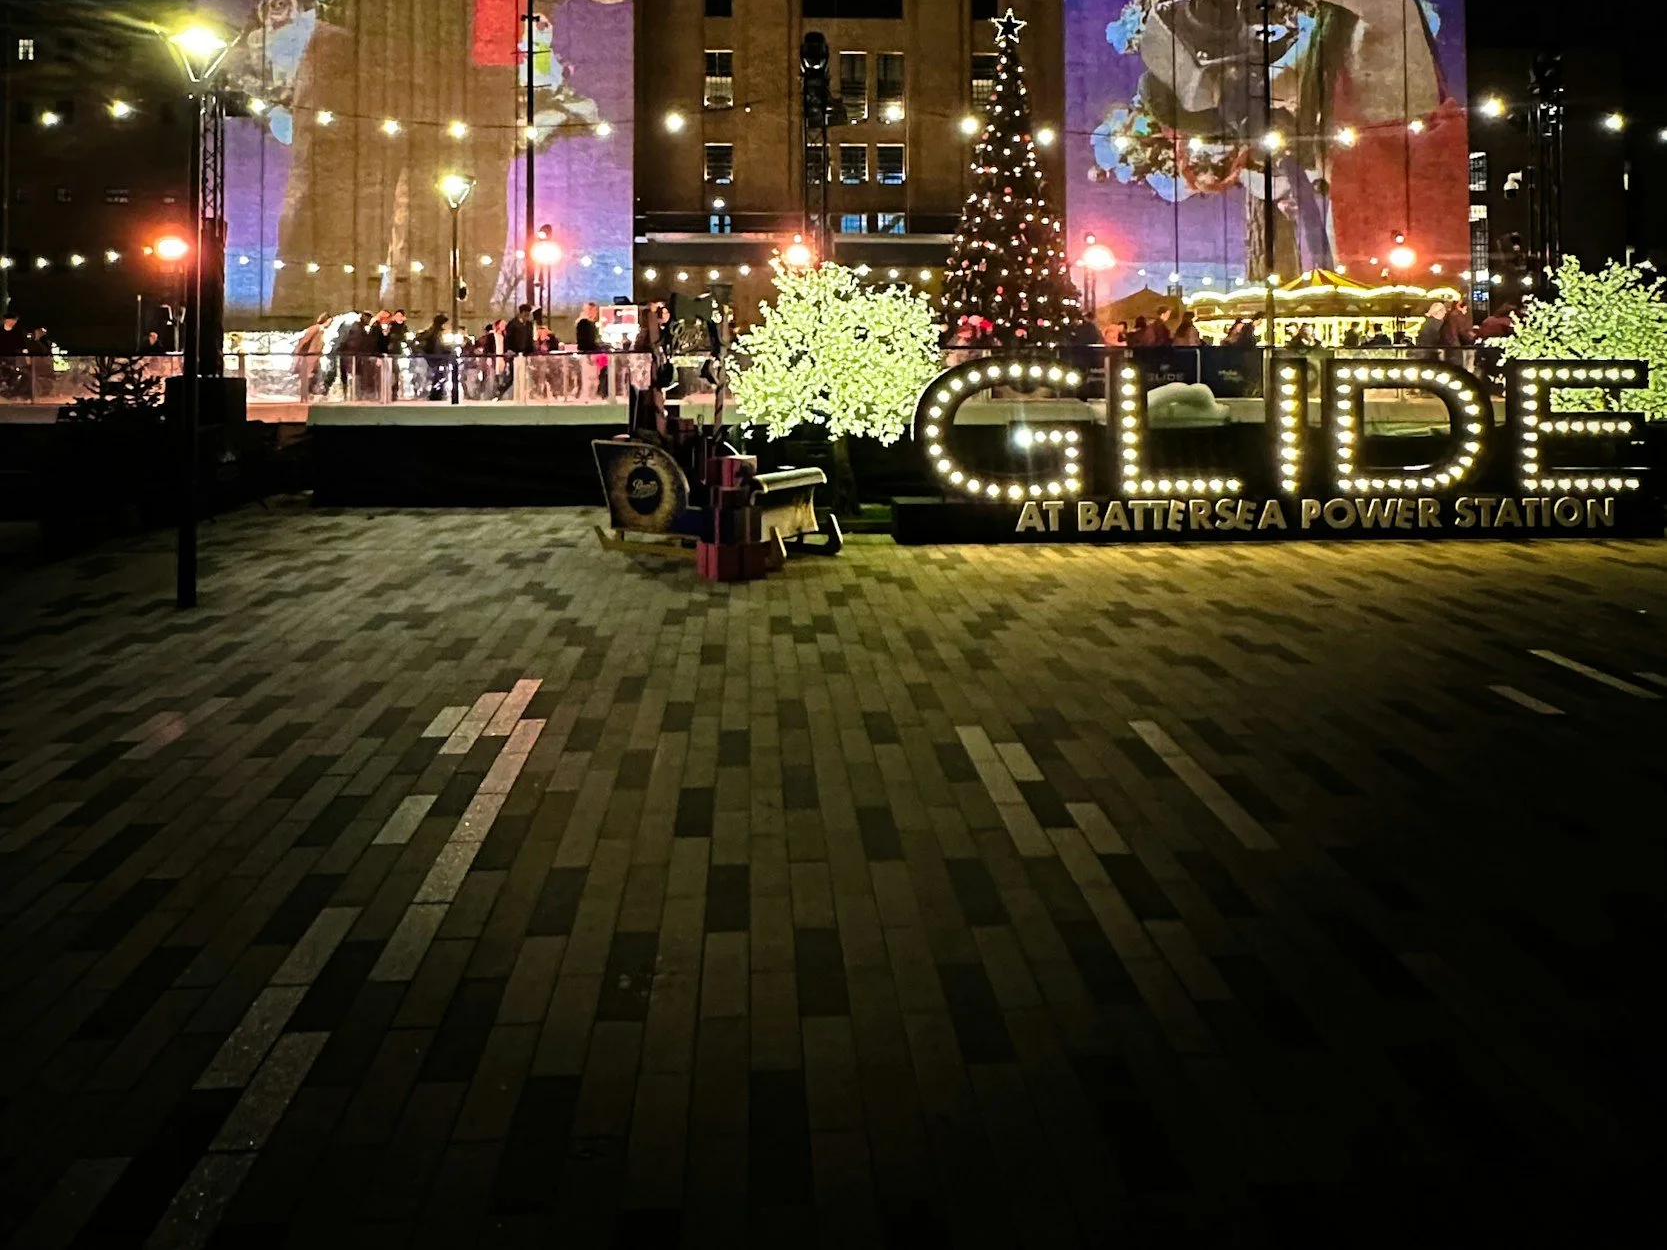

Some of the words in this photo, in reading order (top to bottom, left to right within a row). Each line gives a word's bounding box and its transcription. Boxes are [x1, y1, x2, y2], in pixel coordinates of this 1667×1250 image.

[914, 358, 1647, 499] GLIDE
[1015, 501, 1063, 532] AT
[1077, 499, 1287, 532] BATTERSEA
[1301, 498, 1442, 529] POWER
[1455, 497, 1615, 528] STATION
